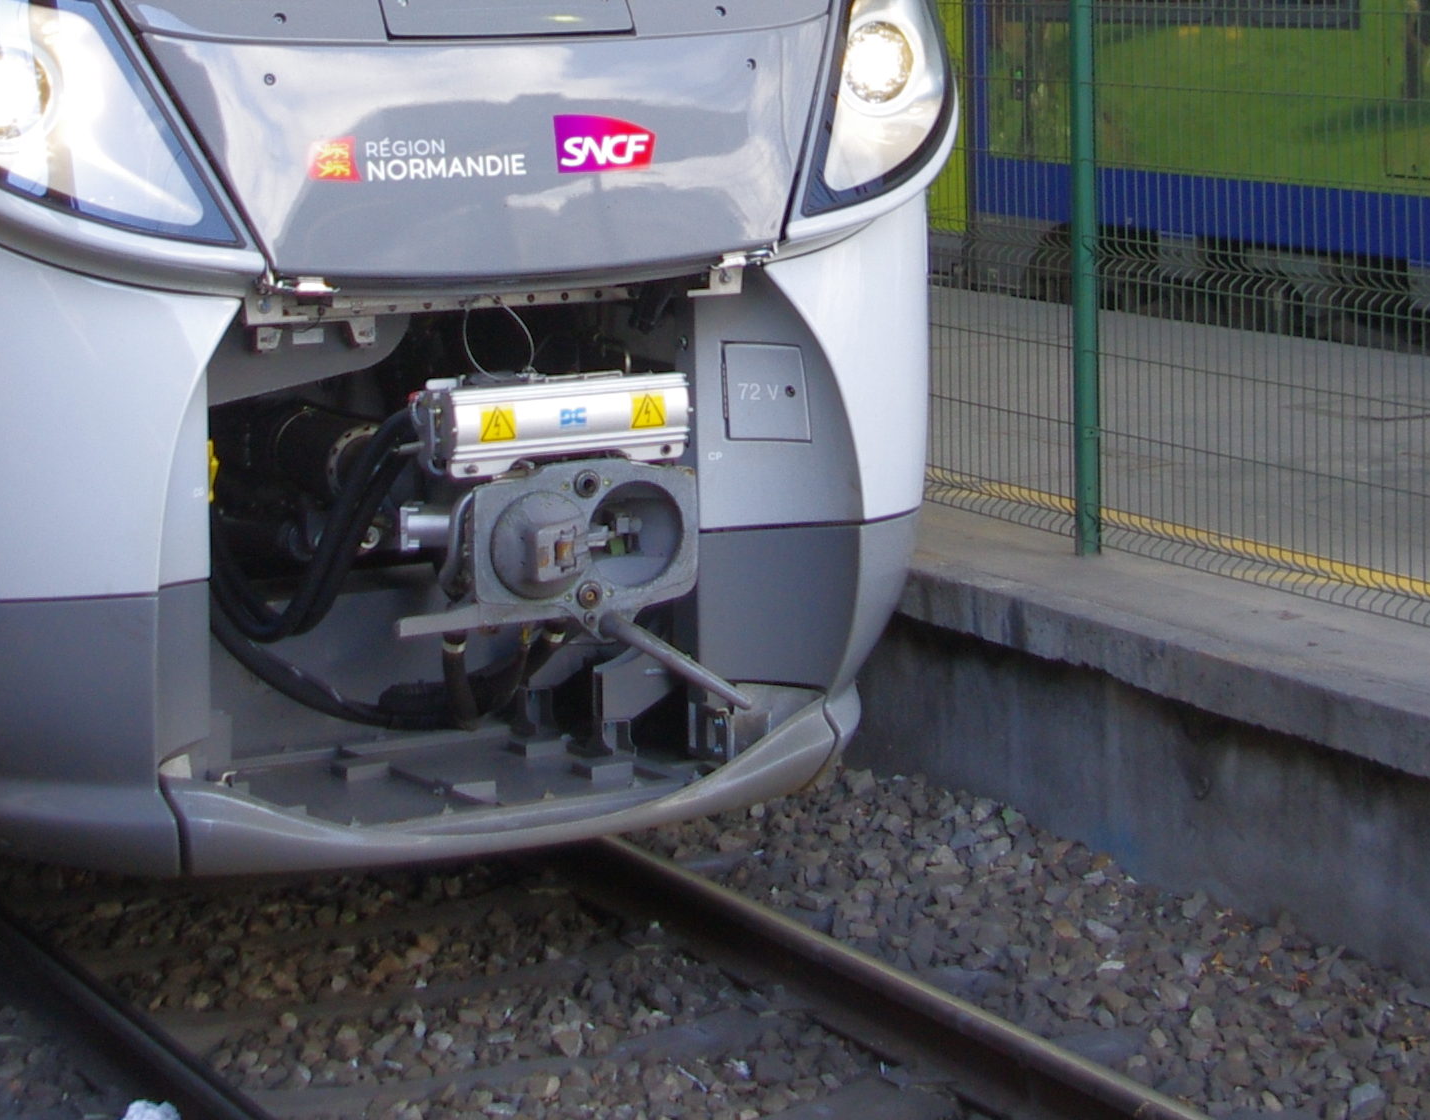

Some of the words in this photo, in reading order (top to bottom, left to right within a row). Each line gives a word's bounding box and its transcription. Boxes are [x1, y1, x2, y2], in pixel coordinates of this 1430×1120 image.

[365, 139, 446, 159] RÉGION
[560, 134, 650, 168] SNCF
[367, 154, 527, 181] NORMANDIE
[737, 383, 761, 401] 72
[766, 384, 779, 401] V
